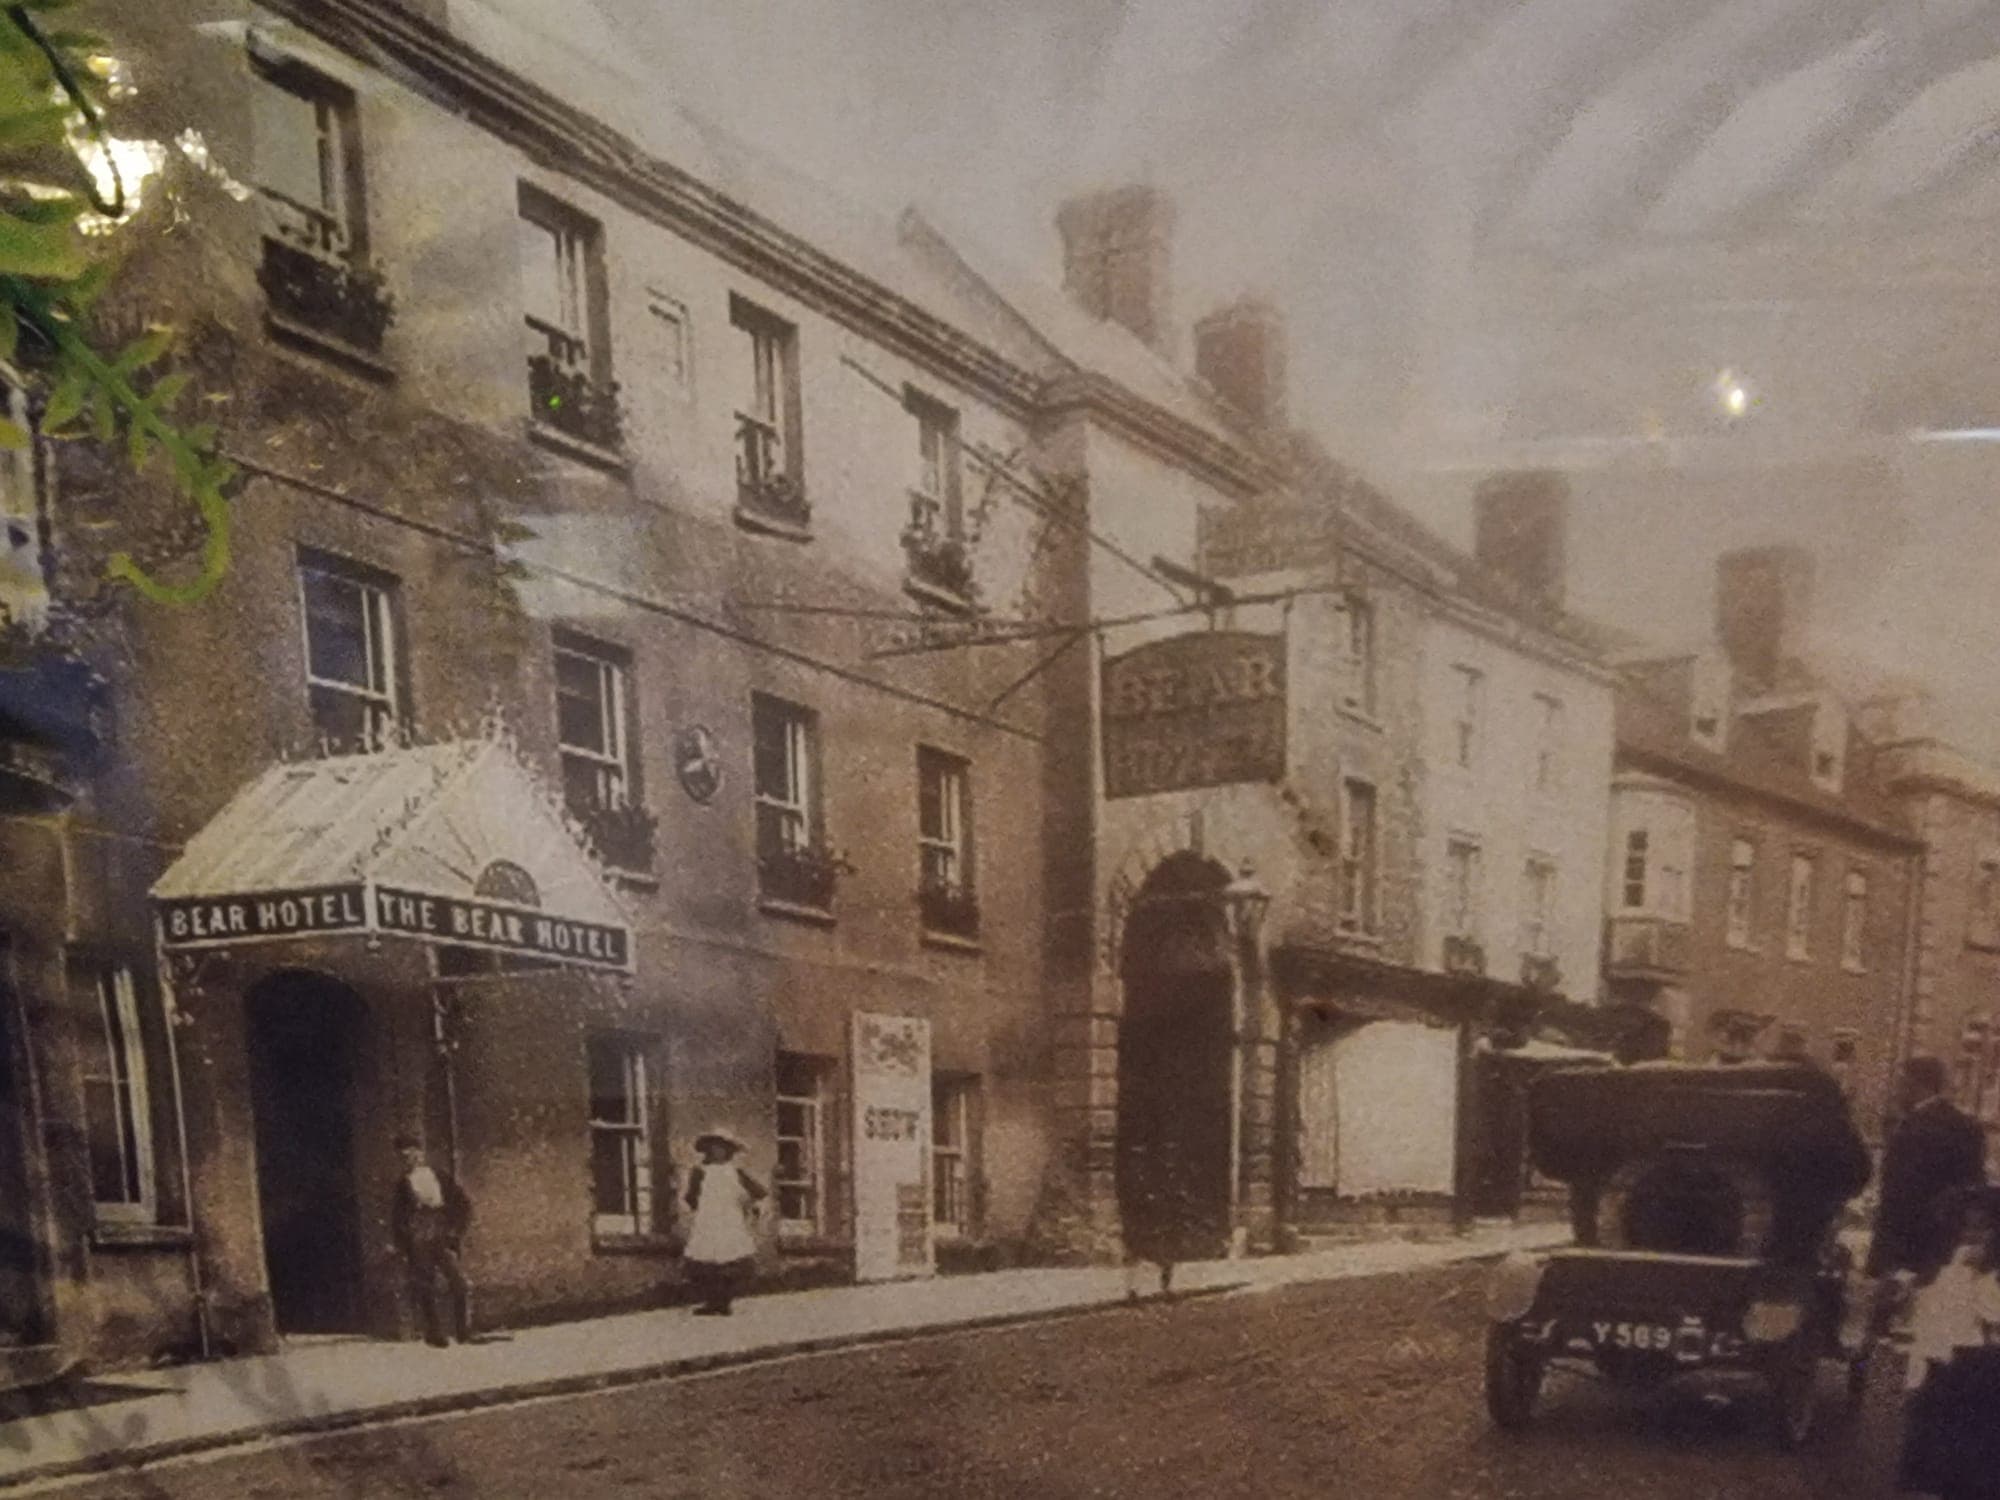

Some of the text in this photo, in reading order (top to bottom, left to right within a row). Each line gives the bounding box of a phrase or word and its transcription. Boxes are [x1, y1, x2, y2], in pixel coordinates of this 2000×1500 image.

[171, 892, 360, 936] BEAR HOTEL
[379, 892, 618, 959] THE BEAR HOTEL
